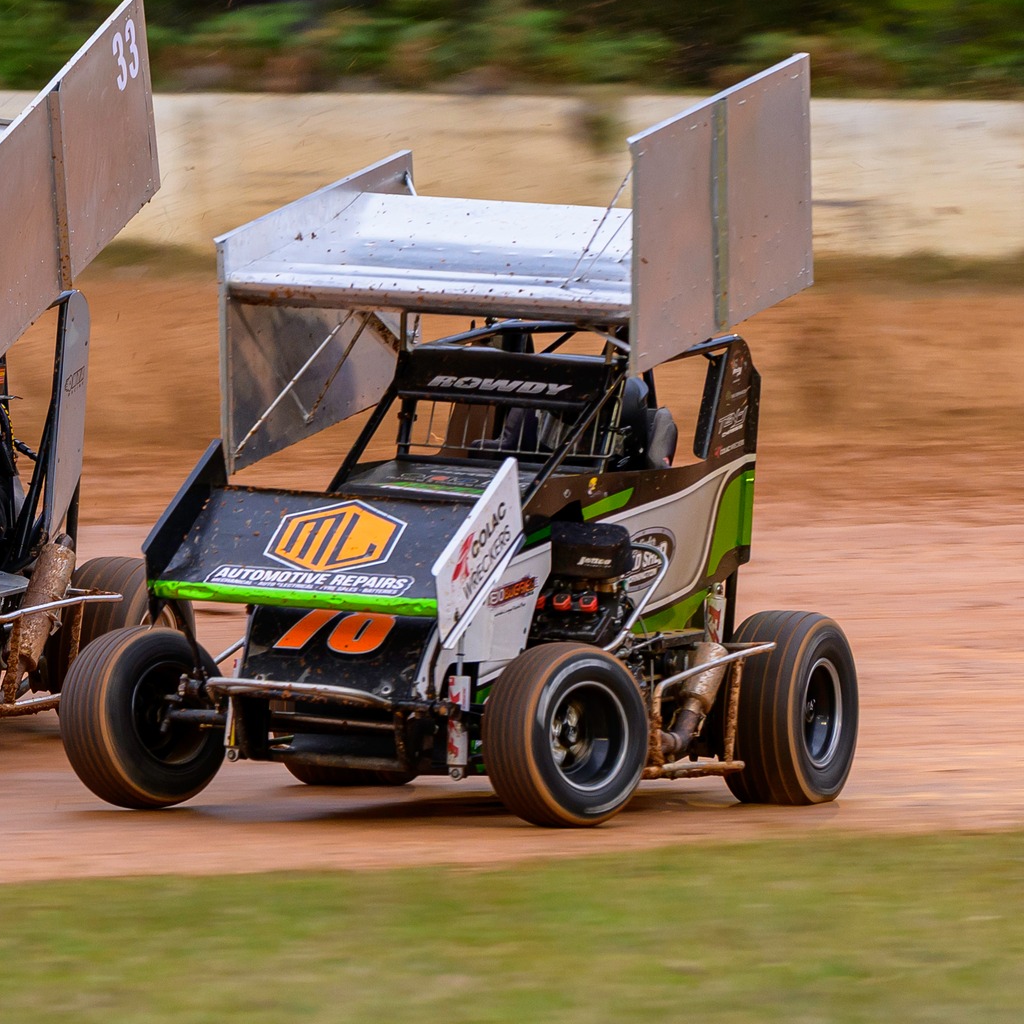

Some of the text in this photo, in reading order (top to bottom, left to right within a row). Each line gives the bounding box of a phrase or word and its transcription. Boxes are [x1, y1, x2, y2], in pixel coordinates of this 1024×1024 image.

[112, 19, 139, 91] 33
[427, 375, 573, 396] ROWDY
[471, 501, 507, 558] COLAC
[214, 567, 408, 590] AUTOMOTIVE REPAIRS
